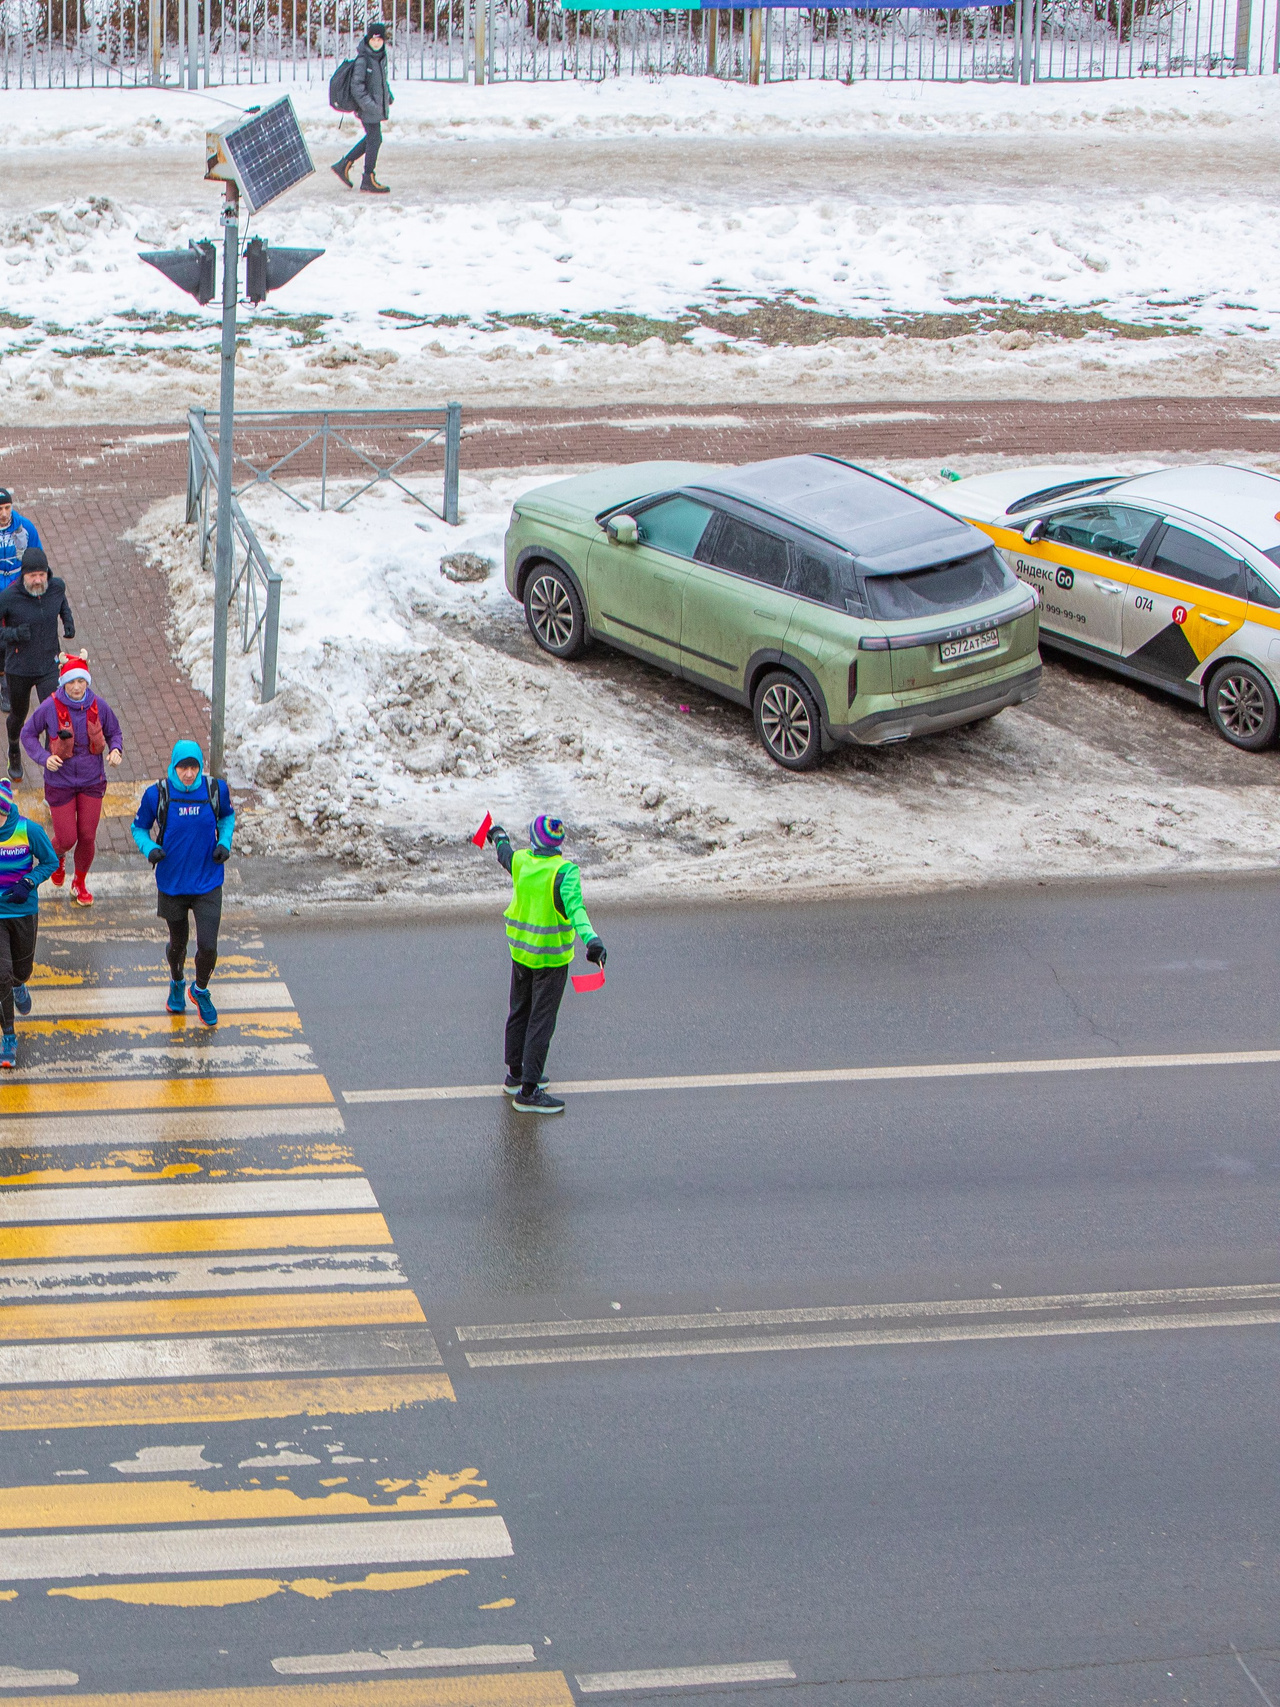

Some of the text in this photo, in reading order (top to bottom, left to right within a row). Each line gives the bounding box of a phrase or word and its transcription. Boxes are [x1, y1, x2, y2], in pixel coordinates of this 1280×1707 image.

[1016, 559, 1054, 581] Яндекс
[1057, 570, 1072, 587] Go
[1135, 595, 1153, 612] 074
[1046, 603, 1086, 624] 999-99-99
[178, 805, 200, 816] ЗАБЕГ
